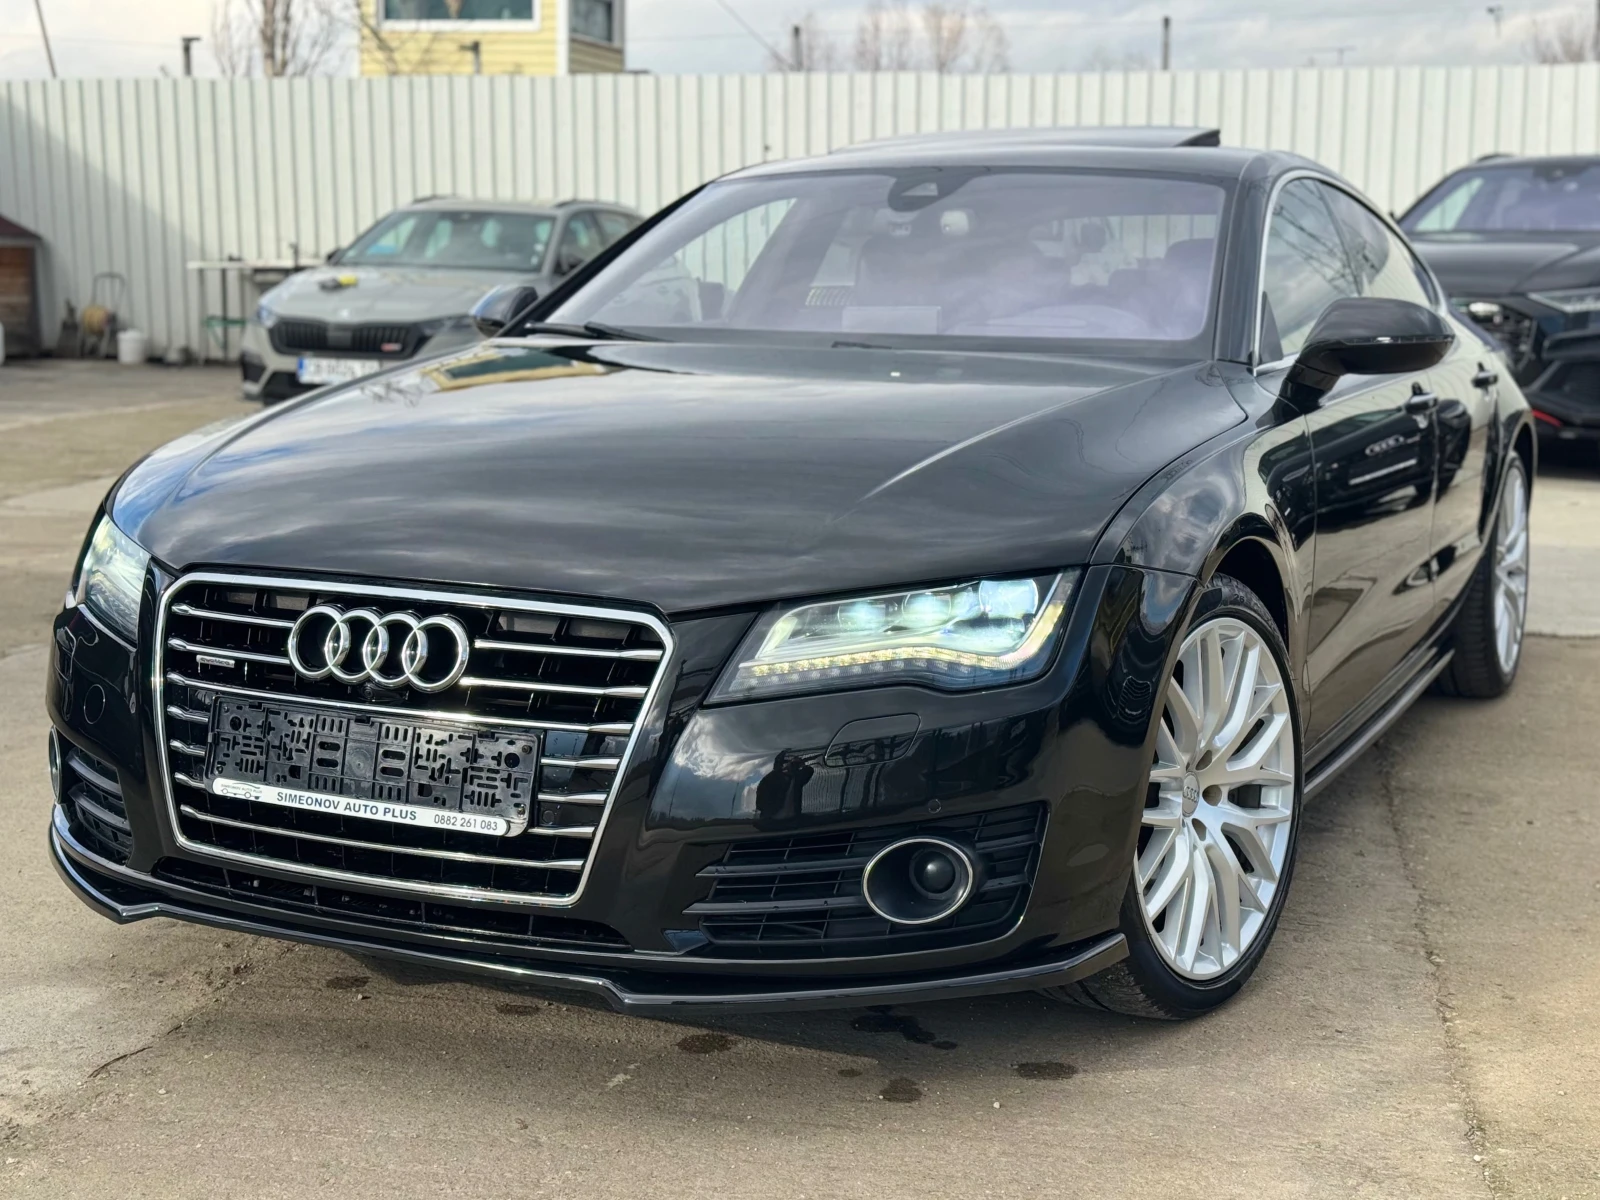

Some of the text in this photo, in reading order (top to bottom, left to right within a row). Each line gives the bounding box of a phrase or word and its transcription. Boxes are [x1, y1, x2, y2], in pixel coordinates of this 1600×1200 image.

[276, 791, 417, 821] SIMEONOV AUTO PLUS
[433, 813, 498, 831] 0882 261 083
